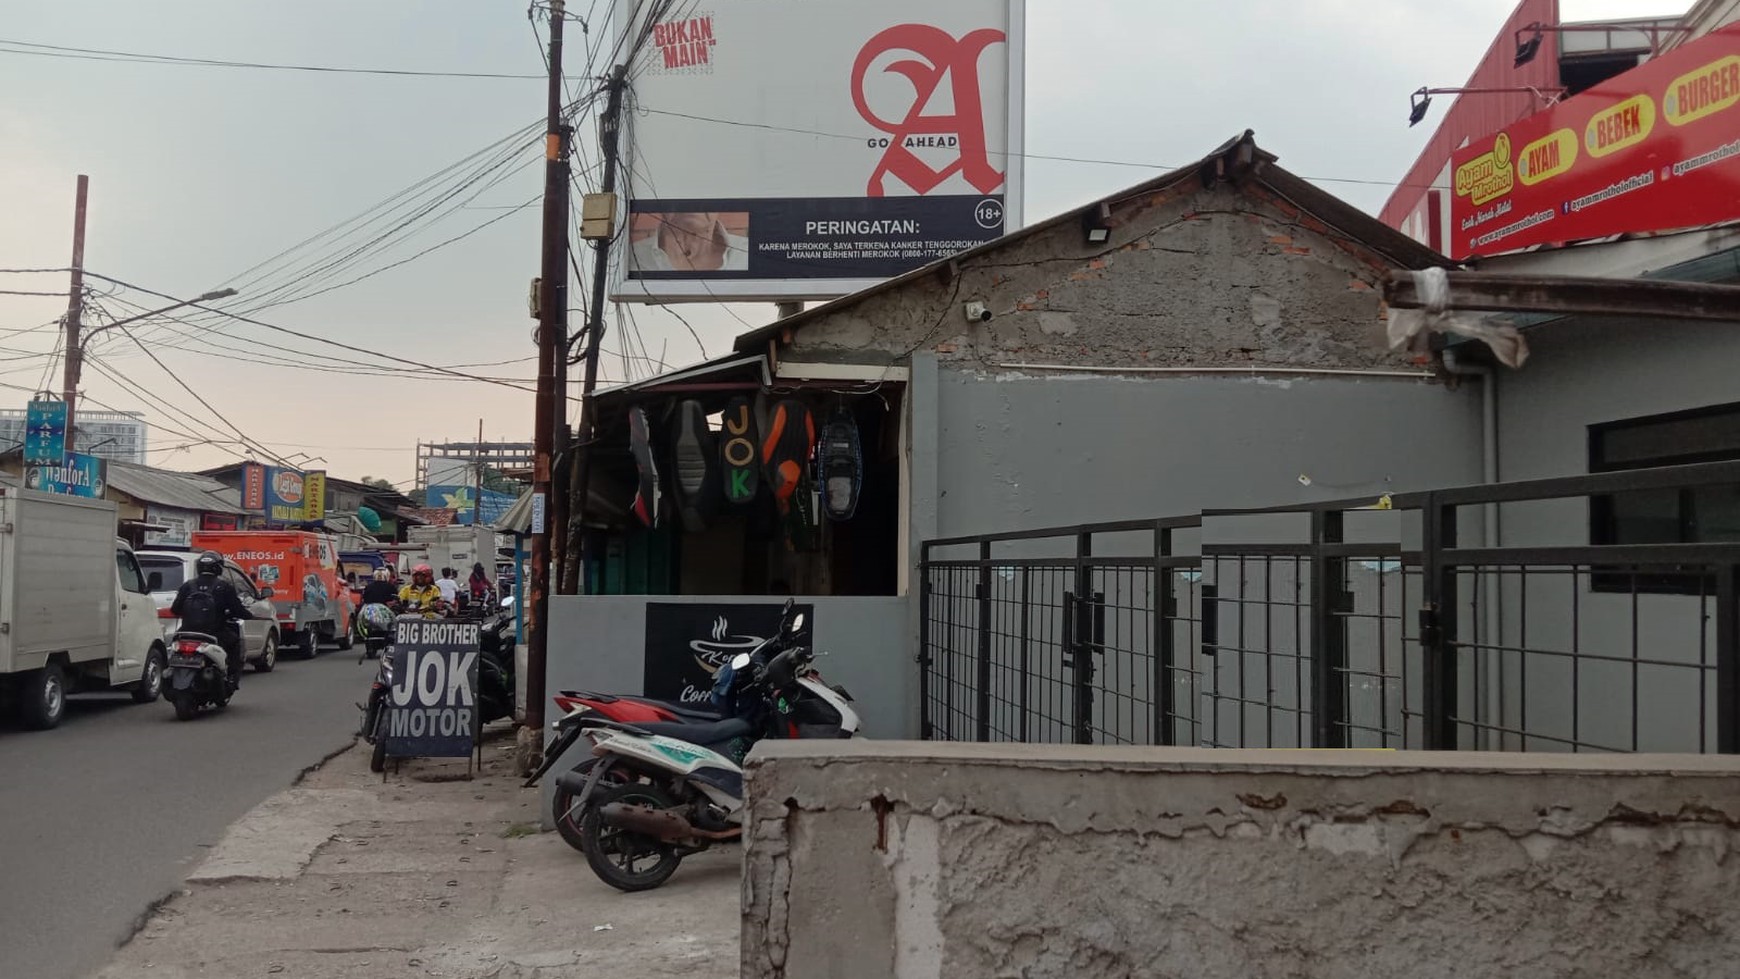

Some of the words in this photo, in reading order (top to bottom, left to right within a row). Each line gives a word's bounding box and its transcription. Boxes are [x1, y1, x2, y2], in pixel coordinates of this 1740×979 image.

[654, 17, 712, 47] BUKAN
[1529, 139, 1560, 178] AYAM
[1597, 104, 1641, 149] BEBEK
[1677, 62, 1740, 117] BURGER
[867, 138, 889, 148] GO
[905, 137, 957, 147] AHEAD
[1458, 160, 1493, 190] Ayam
[1473, 171, 1512, 200] Mrothol
[1571, 170, 1654, 211] ayammrotholofficial
[806, 220, 920, 235] PERINGATAN:
[978, 208, 1001, 219] 18+
[787, 251, 821, 259] LAYANAN
[823, 251, 860, 259] BERHENTI
[862, 250, 900, 258] MEROKOK
[791, 242, 831, 252] MEROKOK,
[834, 242, 851, 250] SAYA
[891, 241, 923, 249] KANKER
[925, 240, 984, 249] TENGGOROKAN
[35, 413, 53, 465] PARFUM
[725, 405, 754, 498] JOK
[398, 623, 418, 644] BIG
[422, 624, 478, 644] BROTHER
[392, 651, 477, 706] JOK
[390, 708, 471, 737] MOTOR
